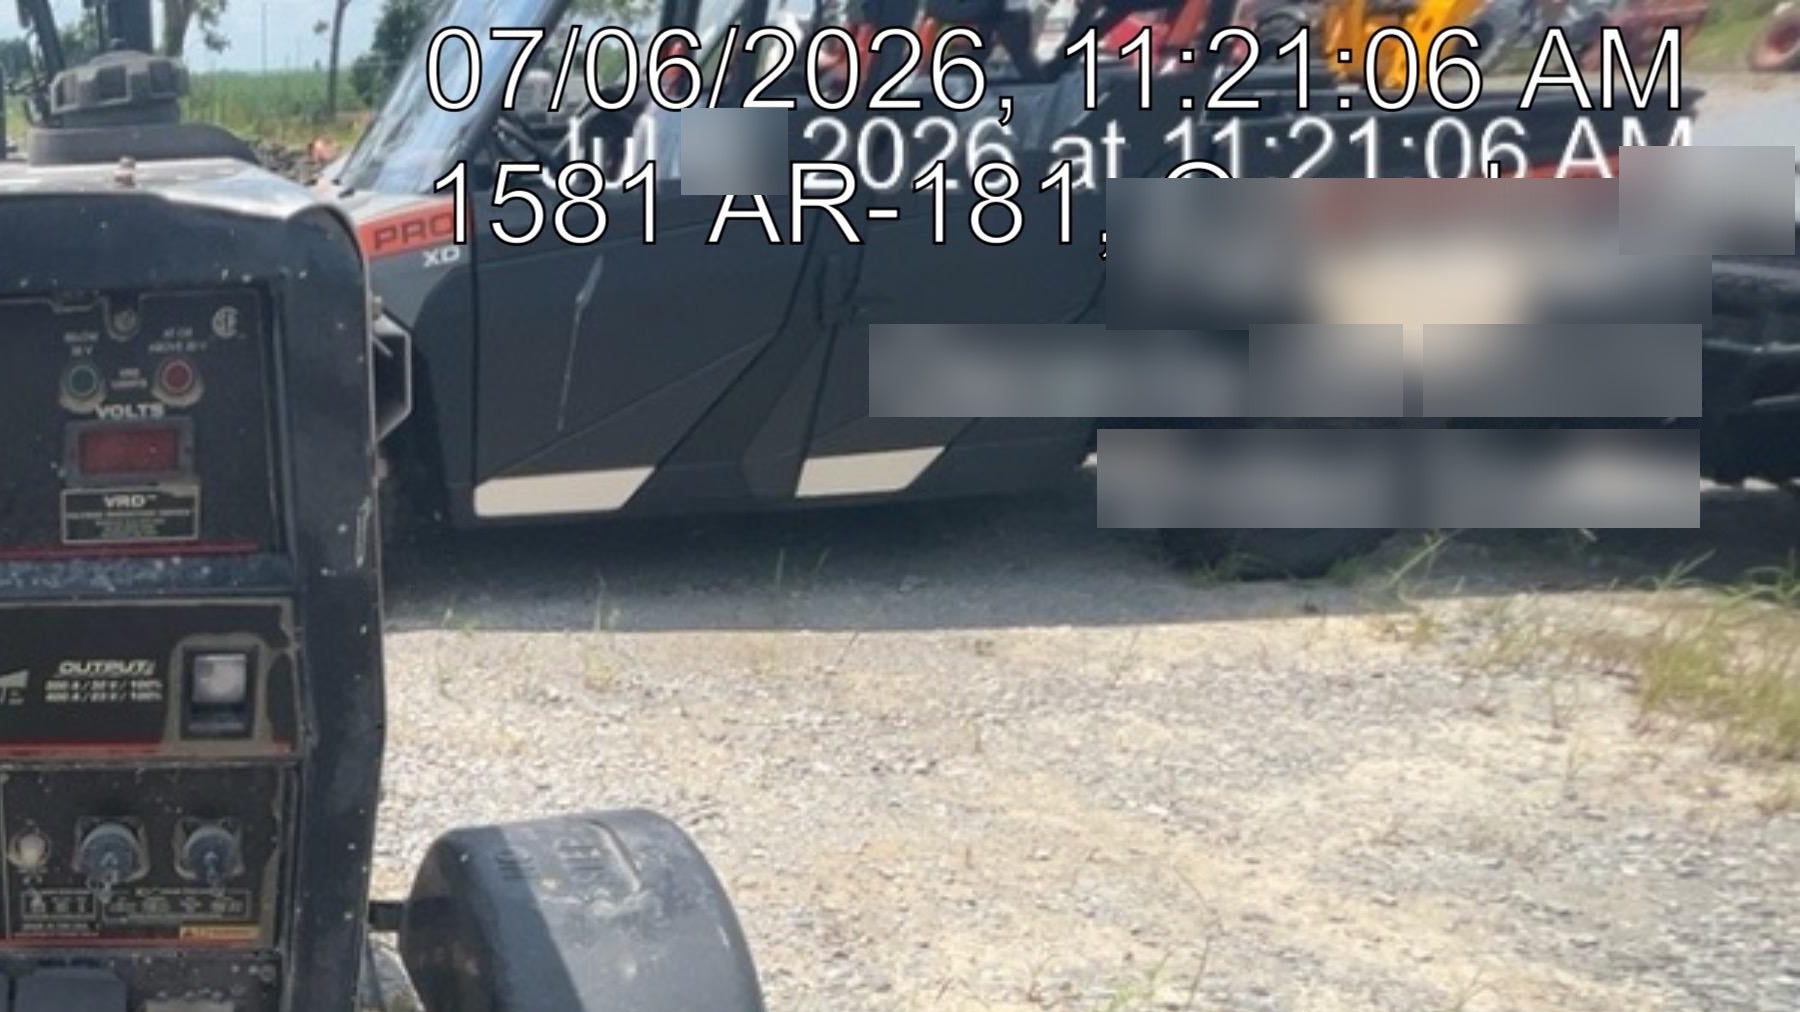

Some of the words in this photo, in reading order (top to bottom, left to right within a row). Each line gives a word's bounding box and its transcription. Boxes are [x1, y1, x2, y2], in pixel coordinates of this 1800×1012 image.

[374, 212, 456, 250] PRO
[422, 245, 460, 268] XD
[93, 403, 165, 419] VOLTS
